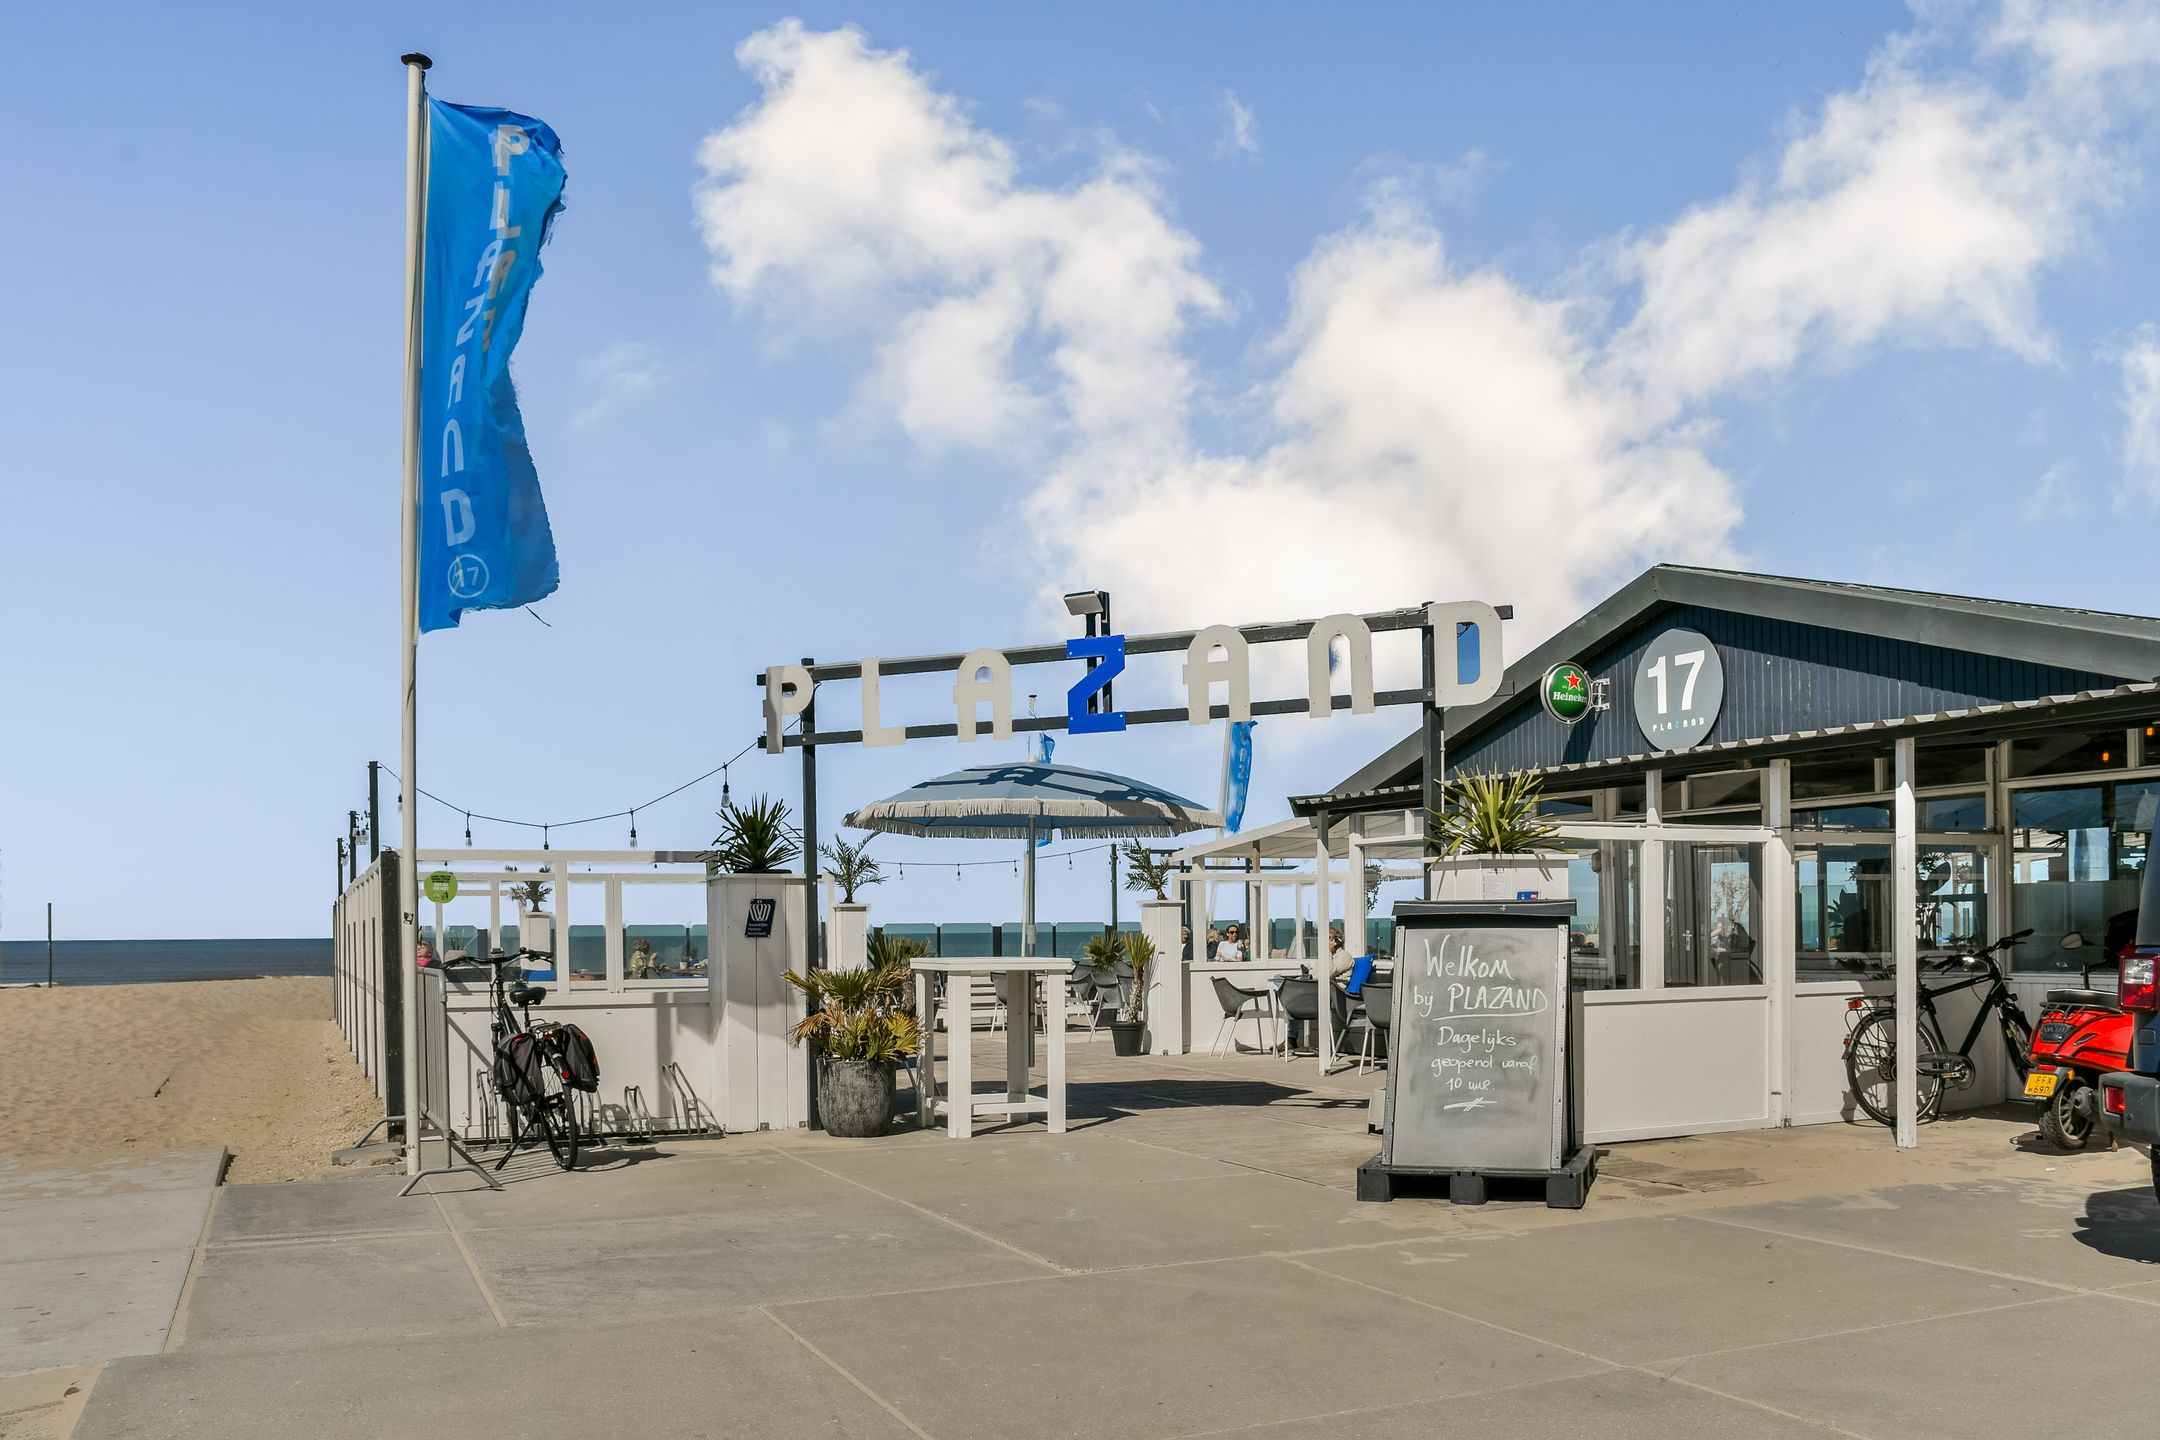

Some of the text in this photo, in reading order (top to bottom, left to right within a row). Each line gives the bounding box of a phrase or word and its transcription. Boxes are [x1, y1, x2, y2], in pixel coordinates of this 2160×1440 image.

[763, 600, 1504, 754] PLAZAND
[1647, 649, 1705, 716] 17
[1652, 716, 1705, 733] PLAZAND
[1423, 934, 1515, 981] Welkom
[1413, 982, 1548, 1018] bij PLAZAND
[1437, 1026, 1517, 1053] Dagelijks
[1430, 1054, 1539, 1077] geopend vanaf
[1446, 1078, 1463, 1091] 10
